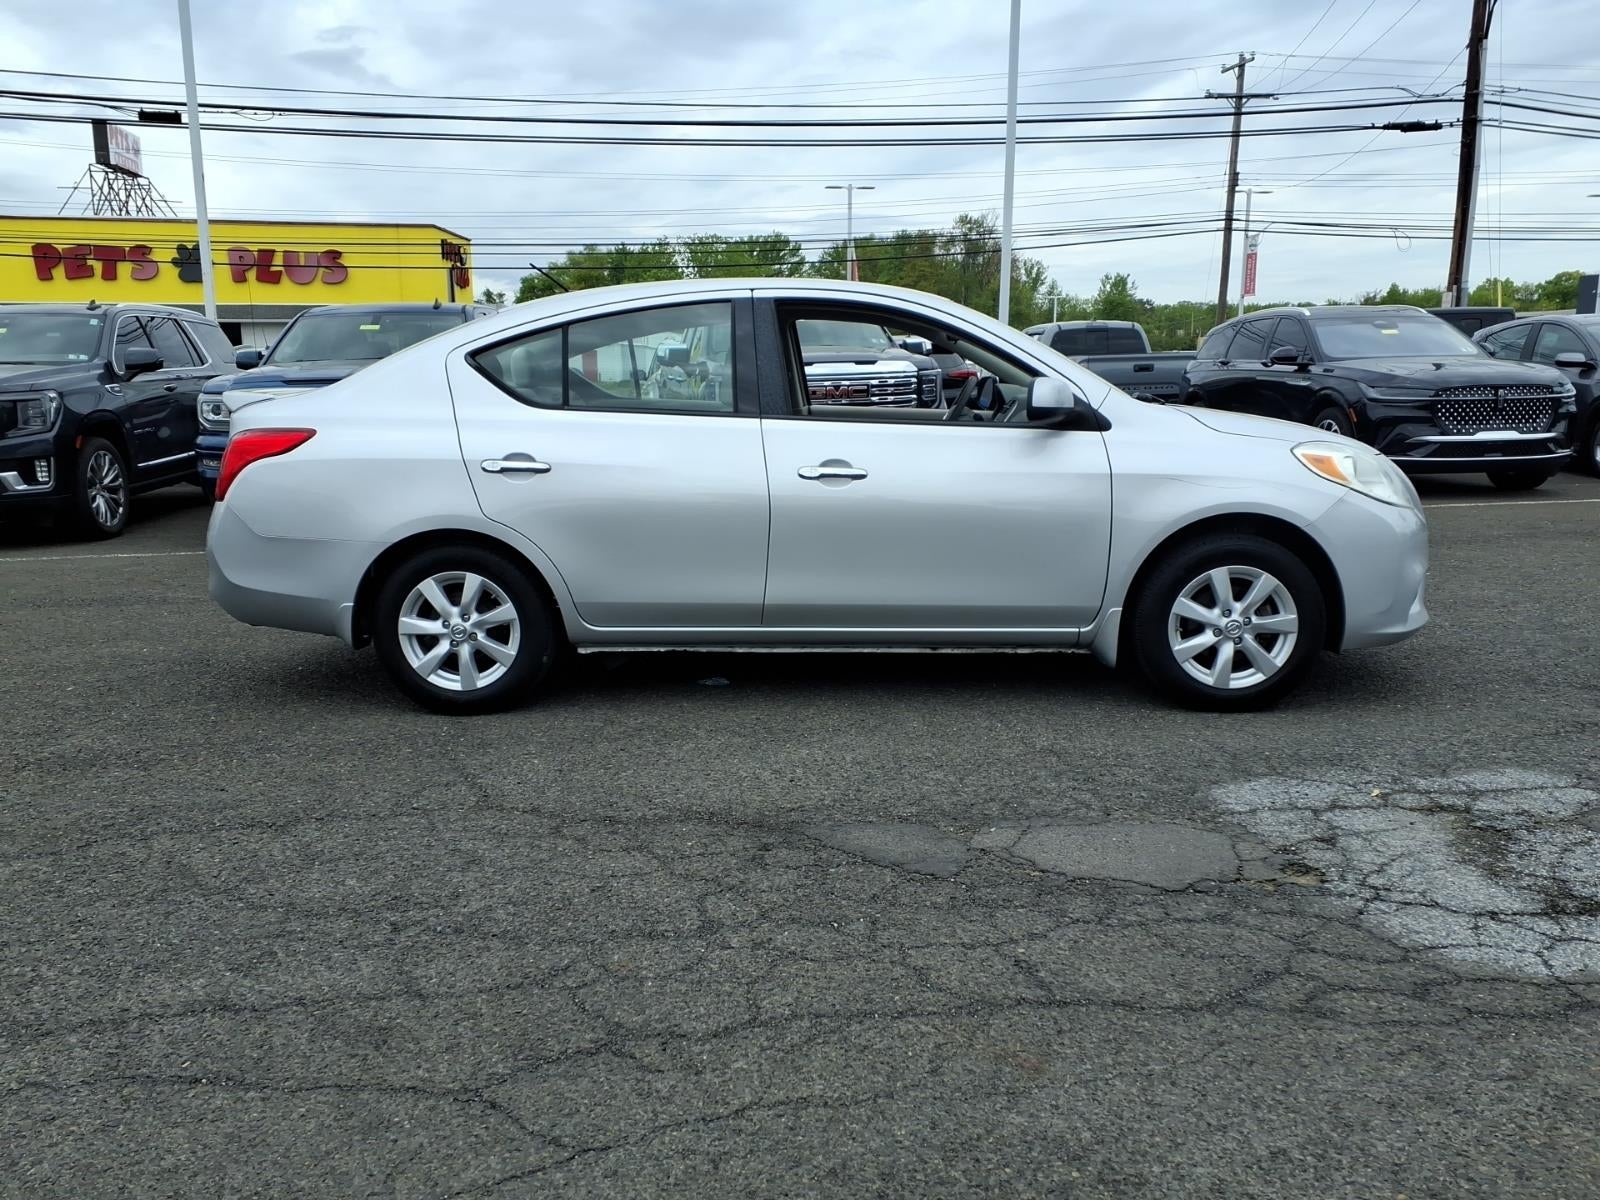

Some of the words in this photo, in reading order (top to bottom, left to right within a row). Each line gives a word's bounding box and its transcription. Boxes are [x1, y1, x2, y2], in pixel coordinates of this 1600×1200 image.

[31, 243, 159, 281] PETS
[226, 246, 348, 285] PLUS
[808, 386, 868, 399] GMC
